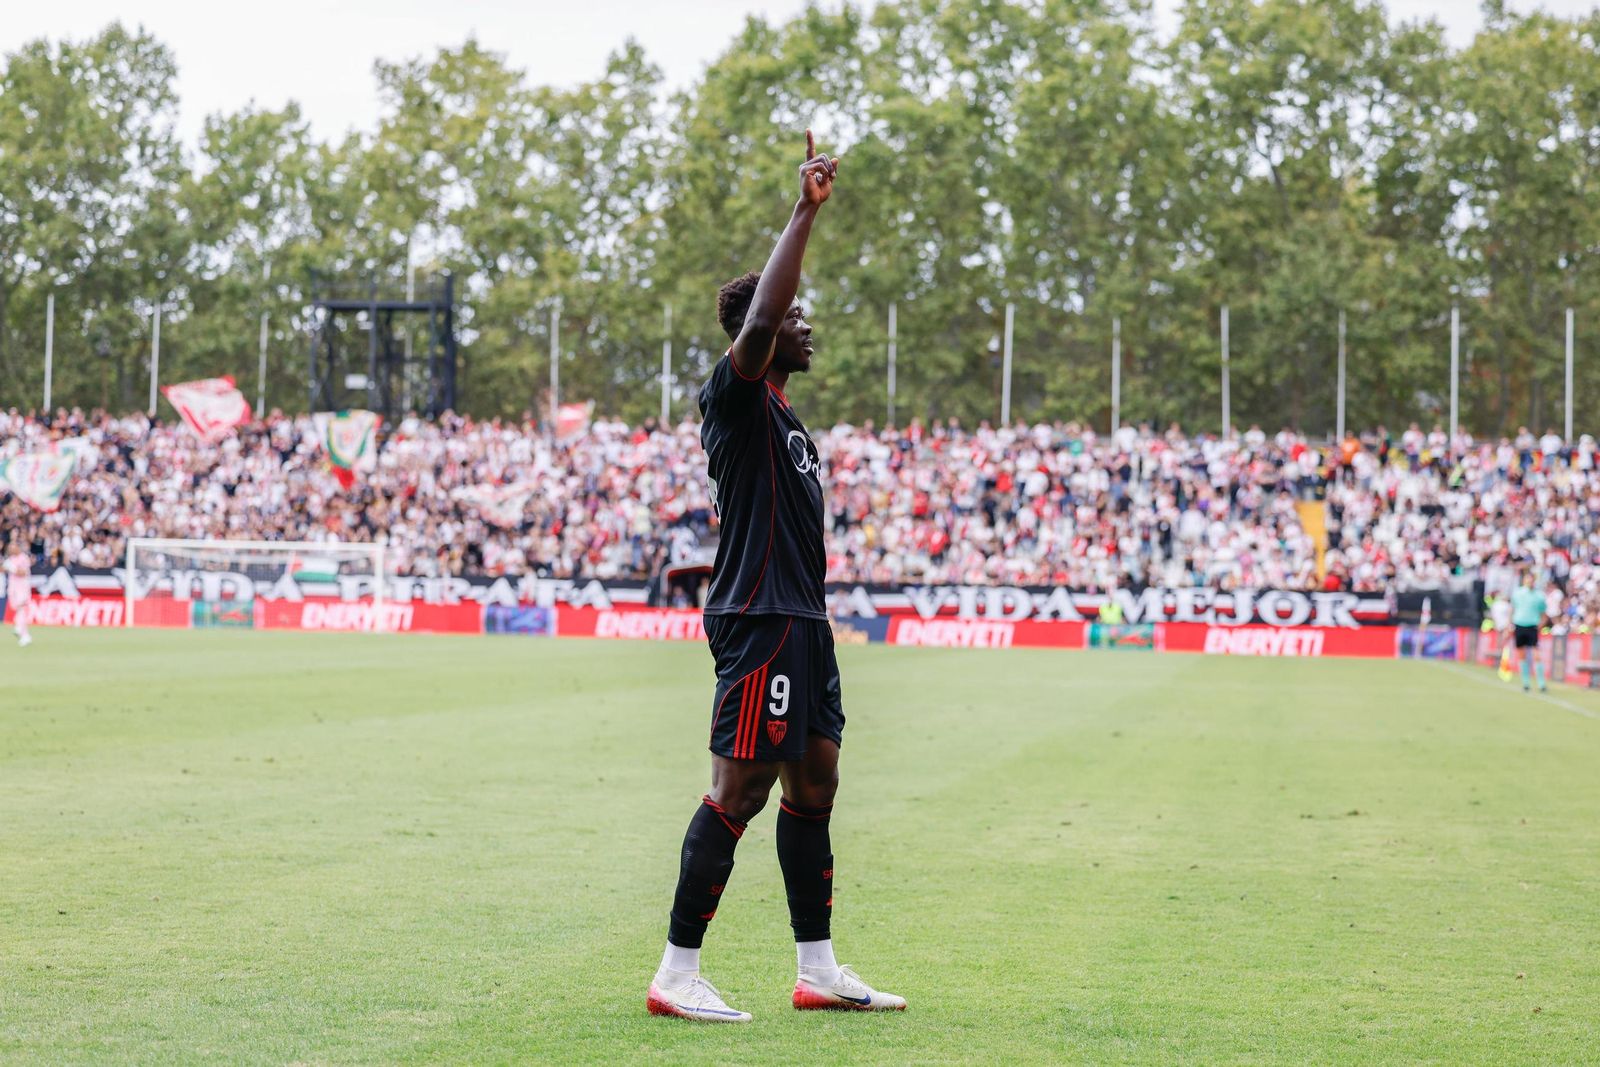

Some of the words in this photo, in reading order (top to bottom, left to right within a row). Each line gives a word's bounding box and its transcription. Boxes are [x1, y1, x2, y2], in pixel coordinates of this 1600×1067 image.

[111, 567, 304, 602] VIDA
[903, 586, 1085, 621] VIDA
[1112, 587, 1361, 628] MEJOR
[768, 674, 791, 716] 9
